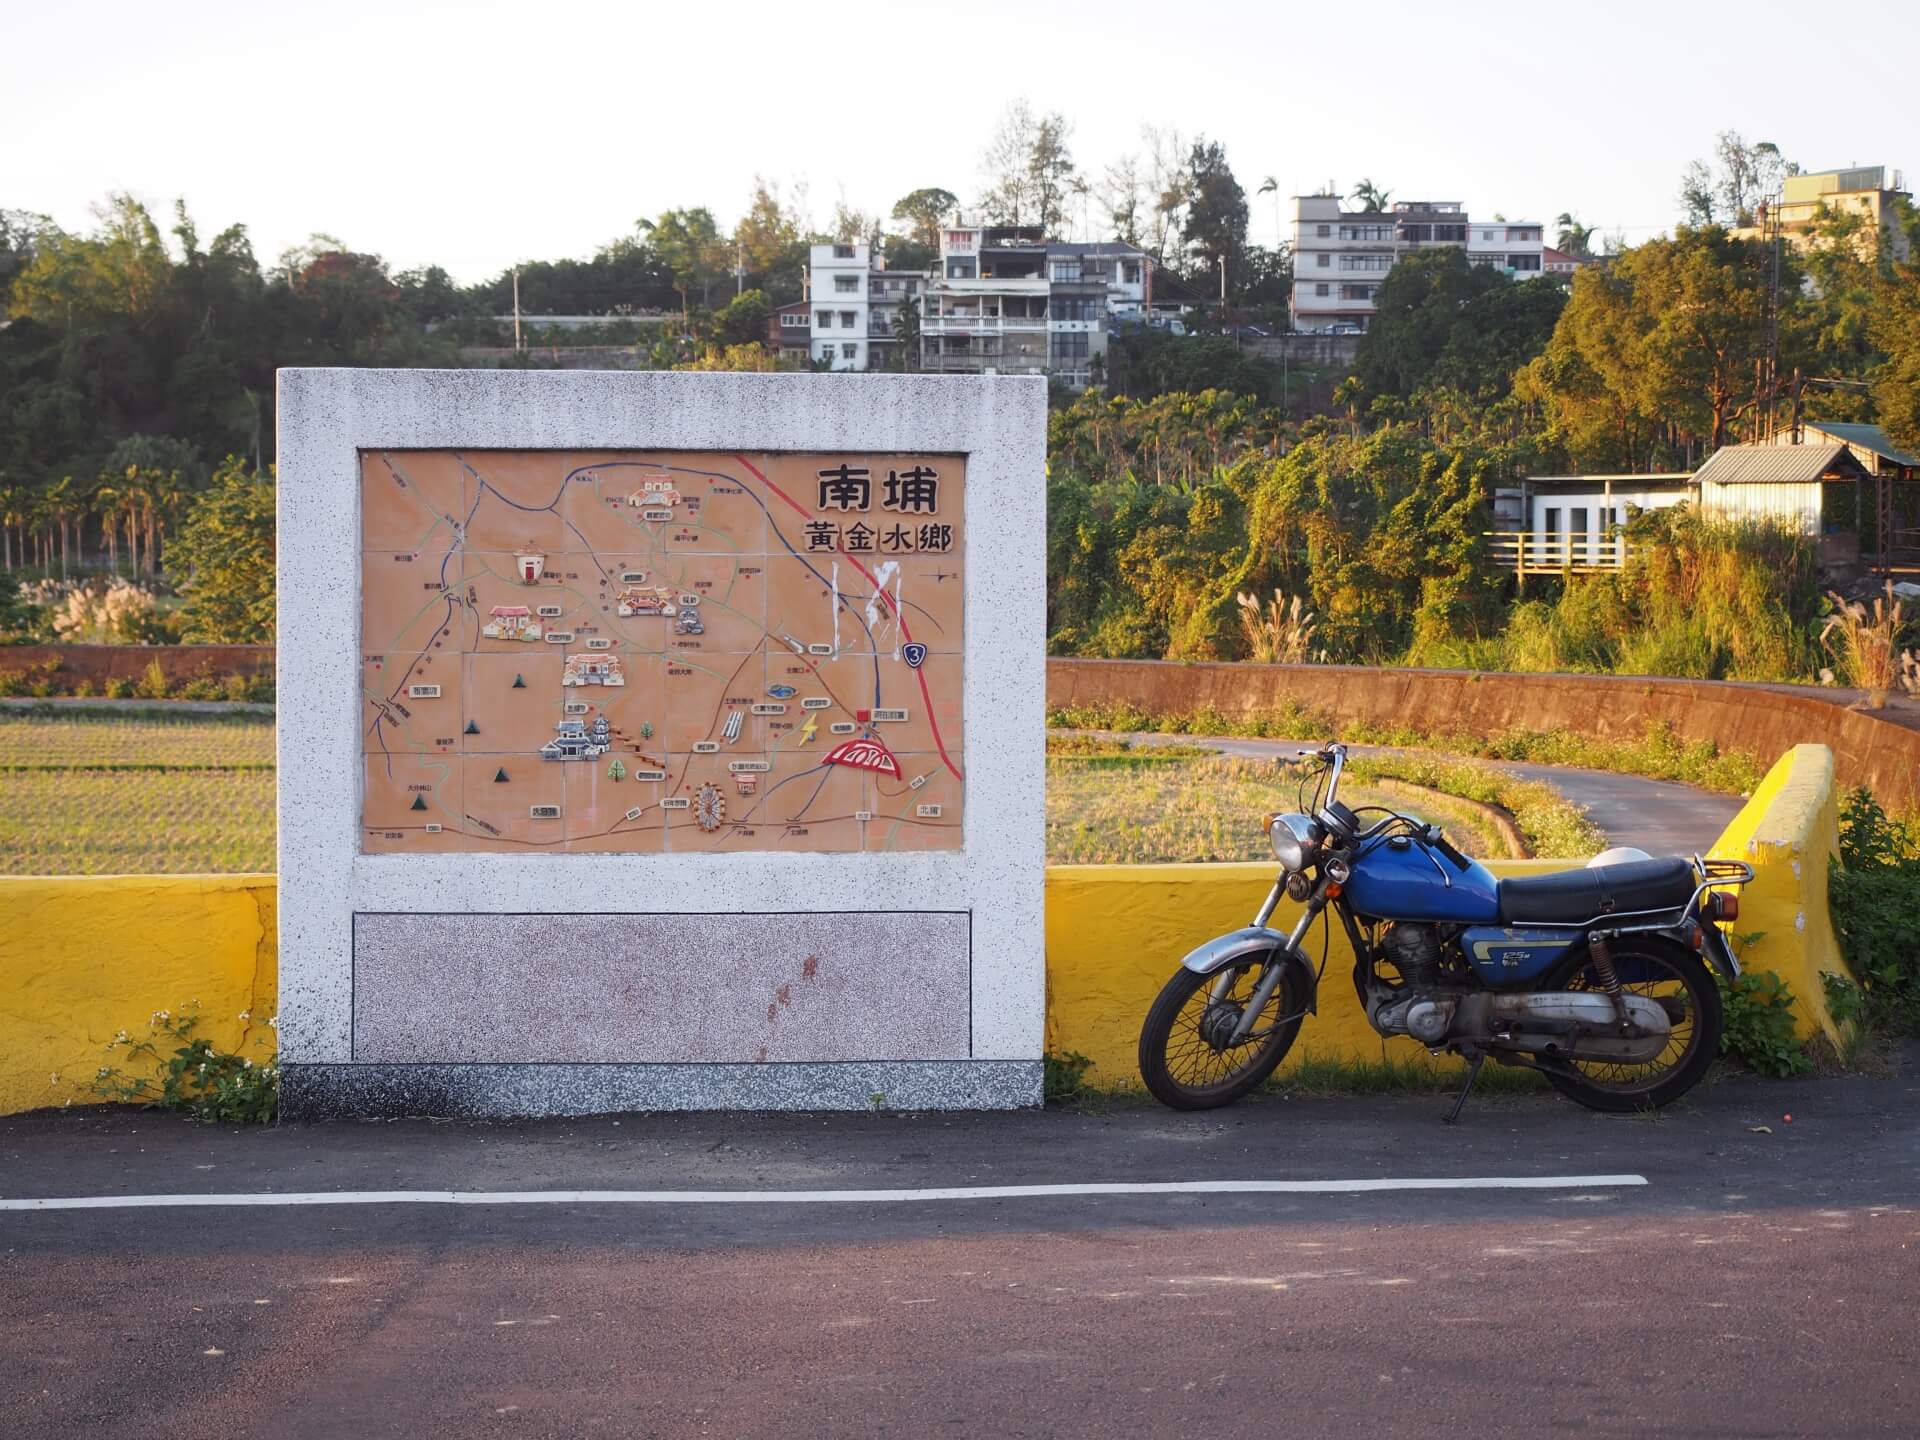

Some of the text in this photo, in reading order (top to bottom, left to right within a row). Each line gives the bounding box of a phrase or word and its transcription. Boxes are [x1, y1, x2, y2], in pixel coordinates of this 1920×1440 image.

[819, 464, 937, 512] 南埔
[805, 521, 951, 550] 黃金水鄉
[910, 647, 920, 663] 3
